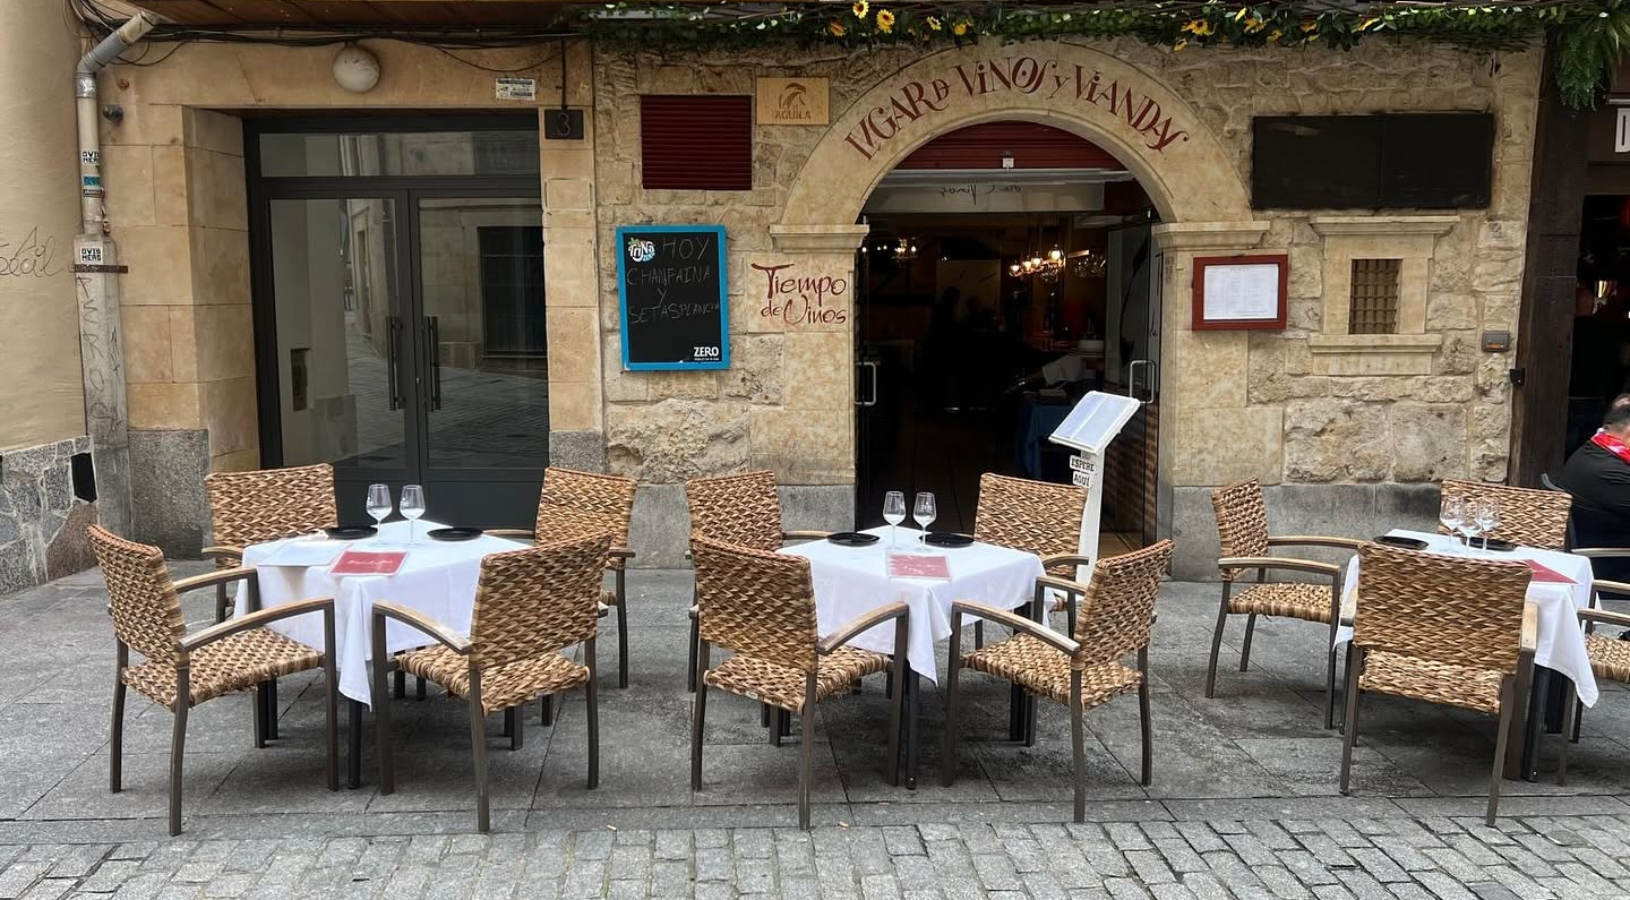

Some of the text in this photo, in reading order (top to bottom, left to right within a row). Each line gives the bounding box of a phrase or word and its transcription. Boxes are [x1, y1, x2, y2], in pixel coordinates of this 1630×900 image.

[557, 112, 571, 137] 3
[662, 238, 709, 260] HOY
[626, 266, 710, 287] CHANFAINA
[751, 262, 847, 308] Tiempo
[761, 294, 847, 325] de Vinos
[694, 346, 719, 357] ZERO
[1071, 457, 1095, 472] ESPERE
